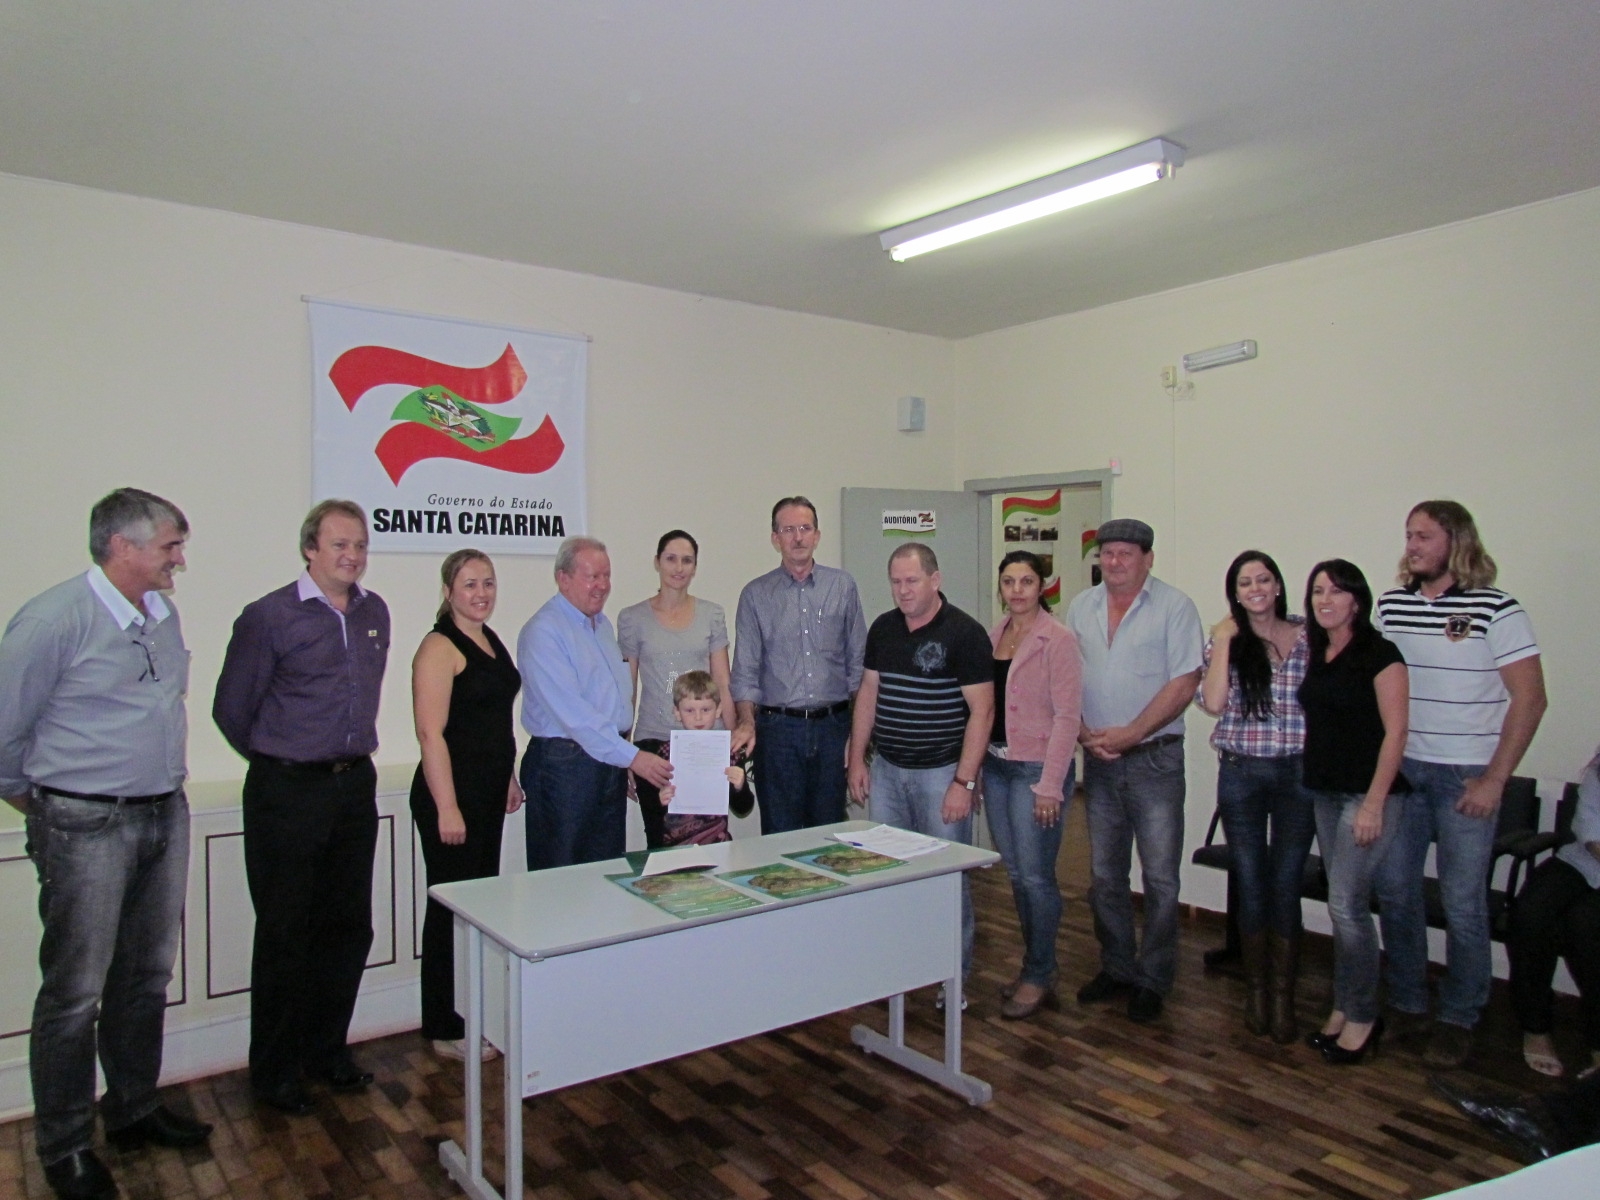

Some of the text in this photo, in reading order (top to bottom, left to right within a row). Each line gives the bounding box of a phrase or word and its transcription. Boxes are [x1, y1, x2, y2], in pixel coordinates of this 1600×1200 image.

[427, 493, 553, 510] Governo do Estado
[373, 508, 566, 537] SANTA CATARINA
[884, 514, 917, 525] AUDITÓRIO
